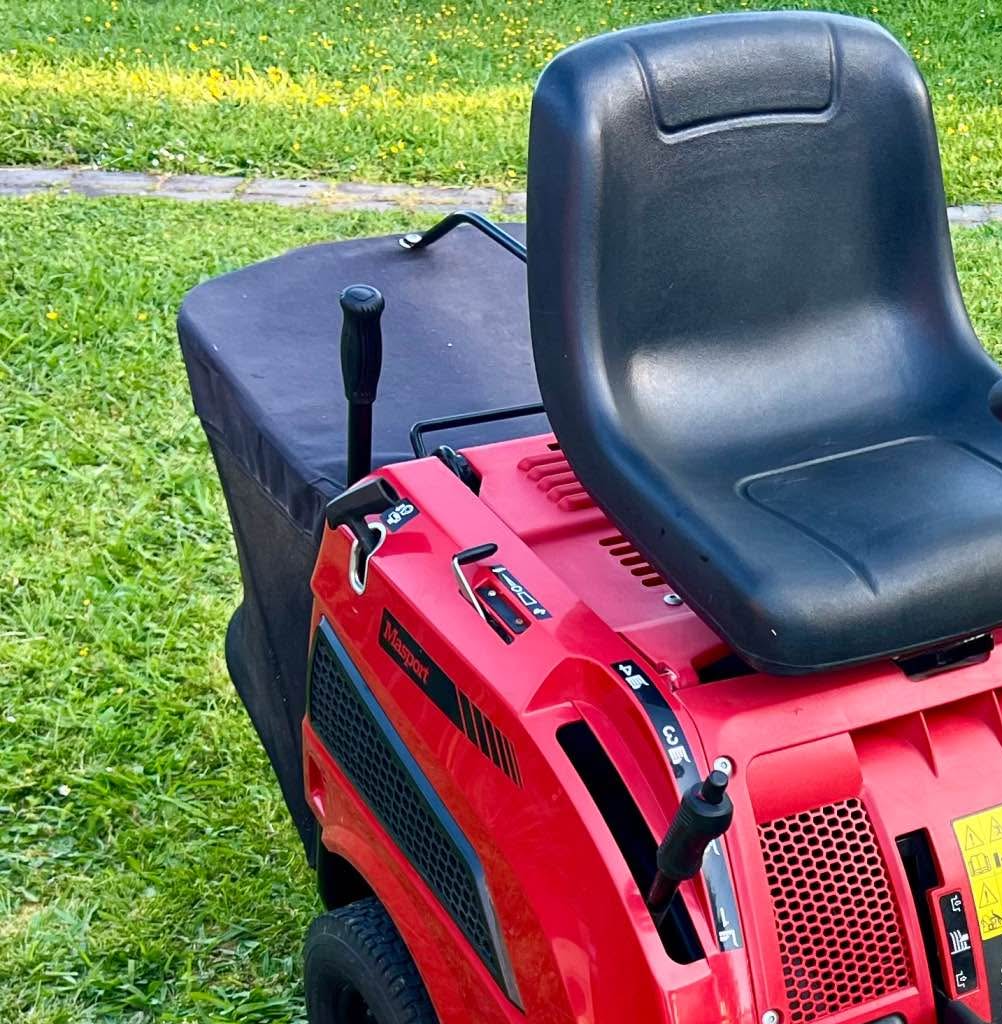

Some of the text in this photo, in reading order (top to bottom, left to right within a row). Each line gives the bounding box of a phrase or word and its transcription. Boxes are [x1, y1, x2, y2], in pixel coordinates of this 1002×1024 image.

[384, 621, 431, 682] Masport
[618, 664, 632, 676] 4
[662, 725, 678, 745] 3
